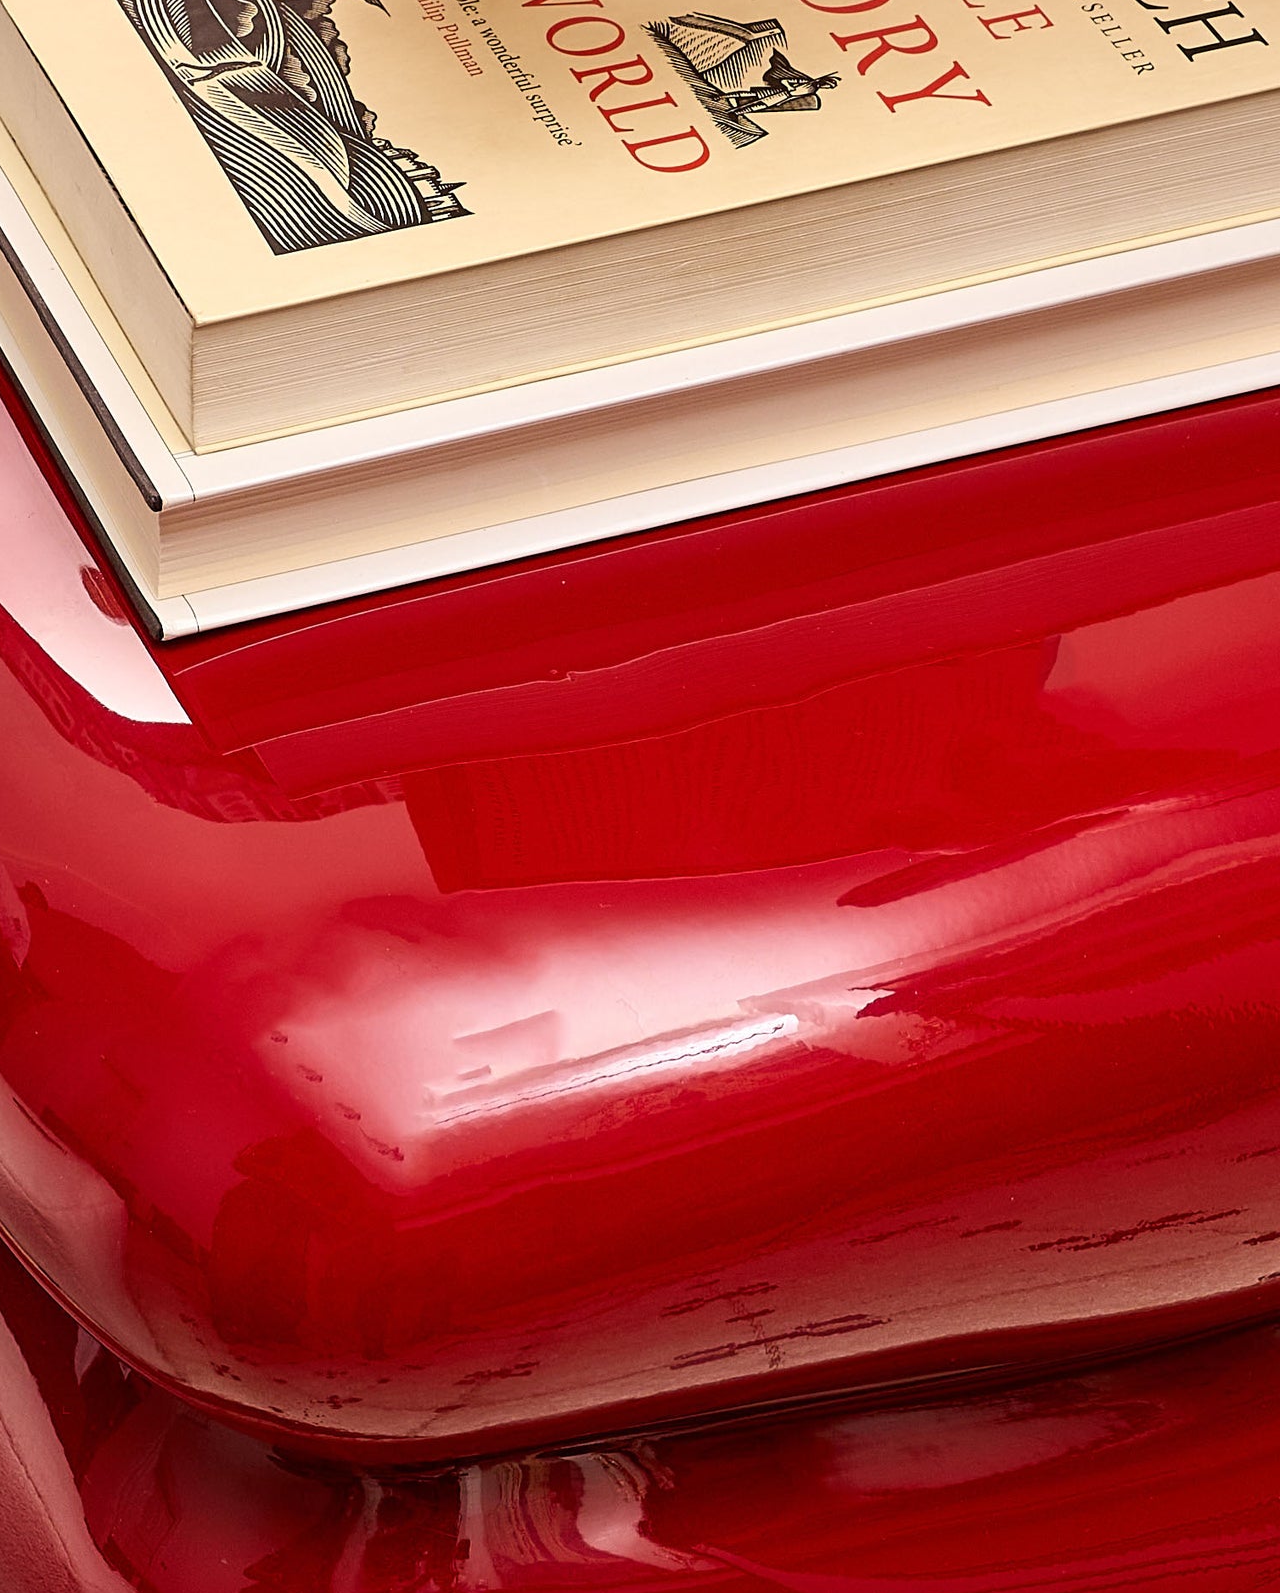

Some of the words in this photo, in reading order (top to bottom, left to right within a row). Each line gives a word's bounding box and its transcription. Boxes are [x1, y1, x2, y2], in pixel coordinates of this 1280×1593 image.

[472, 16, 487, 28] a
[437, 23, 485, 78] Pullman
[479, 26, 533, 93] wonderful
[525, 92, 583, 148] surprise’
